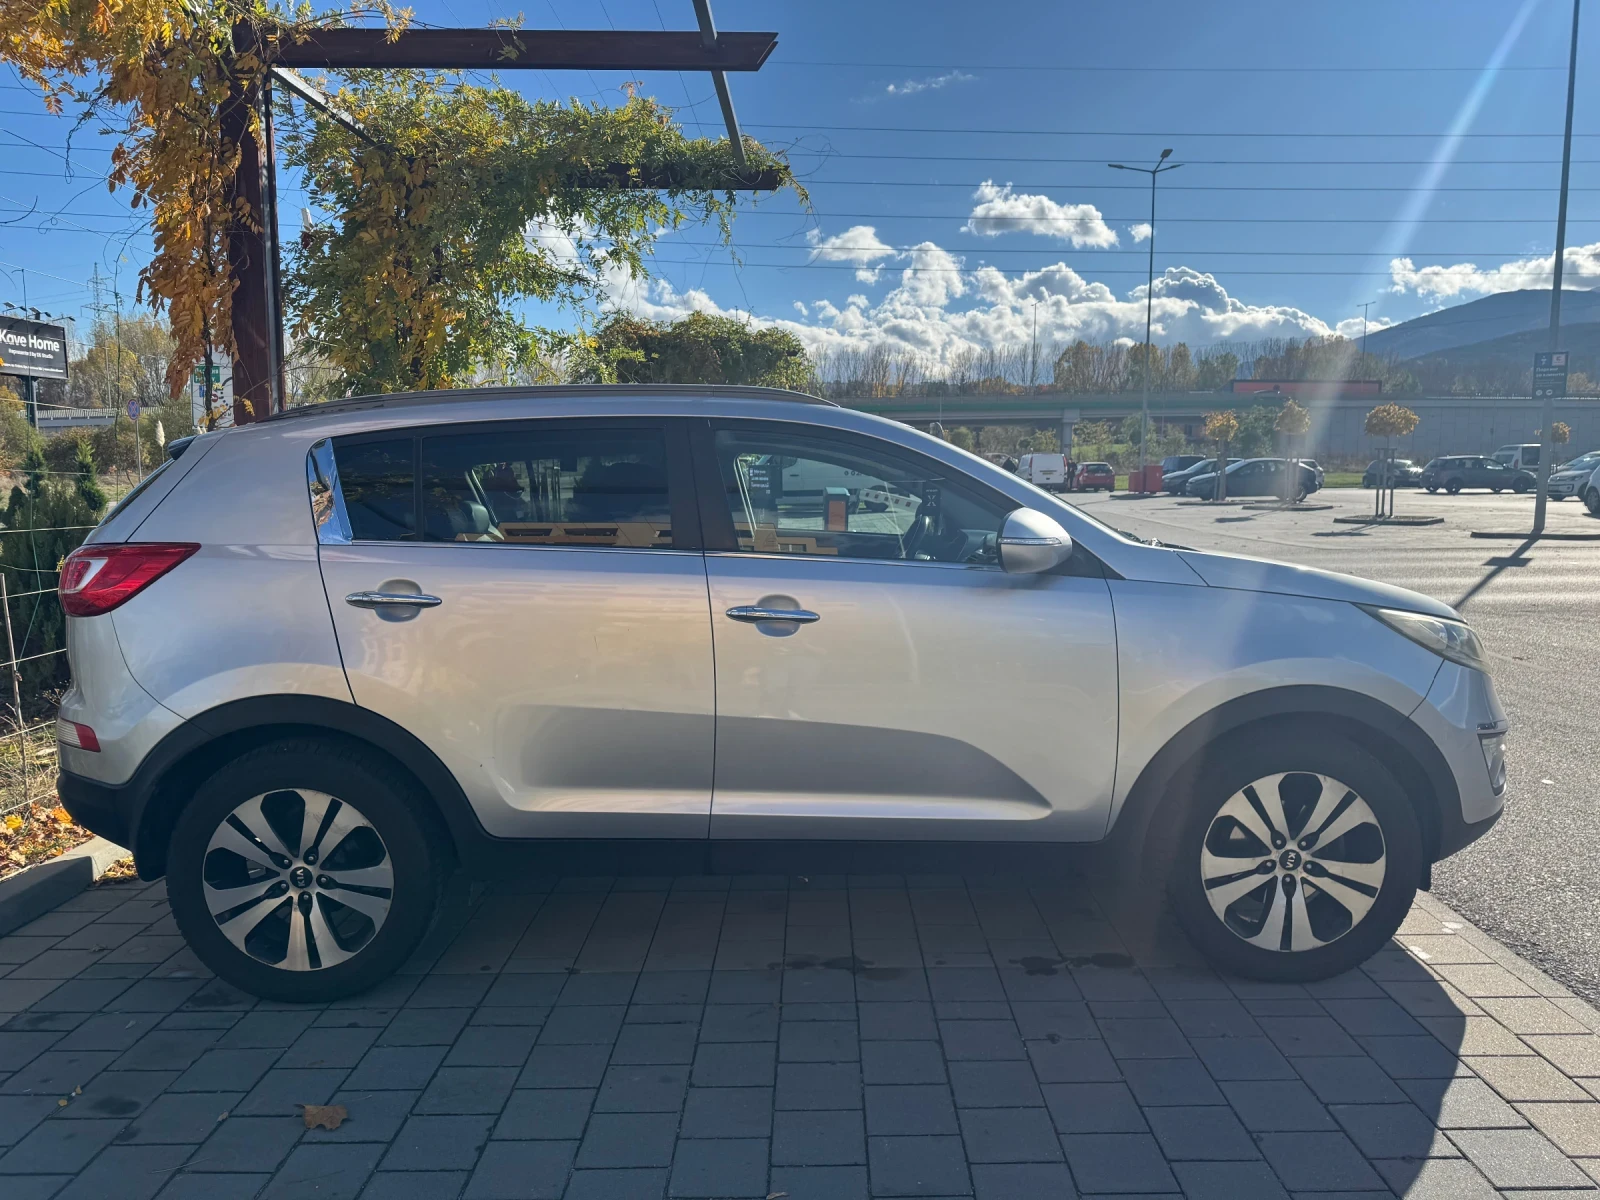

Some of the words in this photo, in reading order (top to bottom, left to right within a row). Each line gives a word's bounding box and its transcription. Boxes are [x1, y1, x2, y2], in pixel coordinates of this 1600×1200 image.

[0, 328, 27, 347] Kave
[28, 334, 60, 352] Home
[1285, 852, 1296, 868] KIA
[296, 868, 305, 887] KIA
